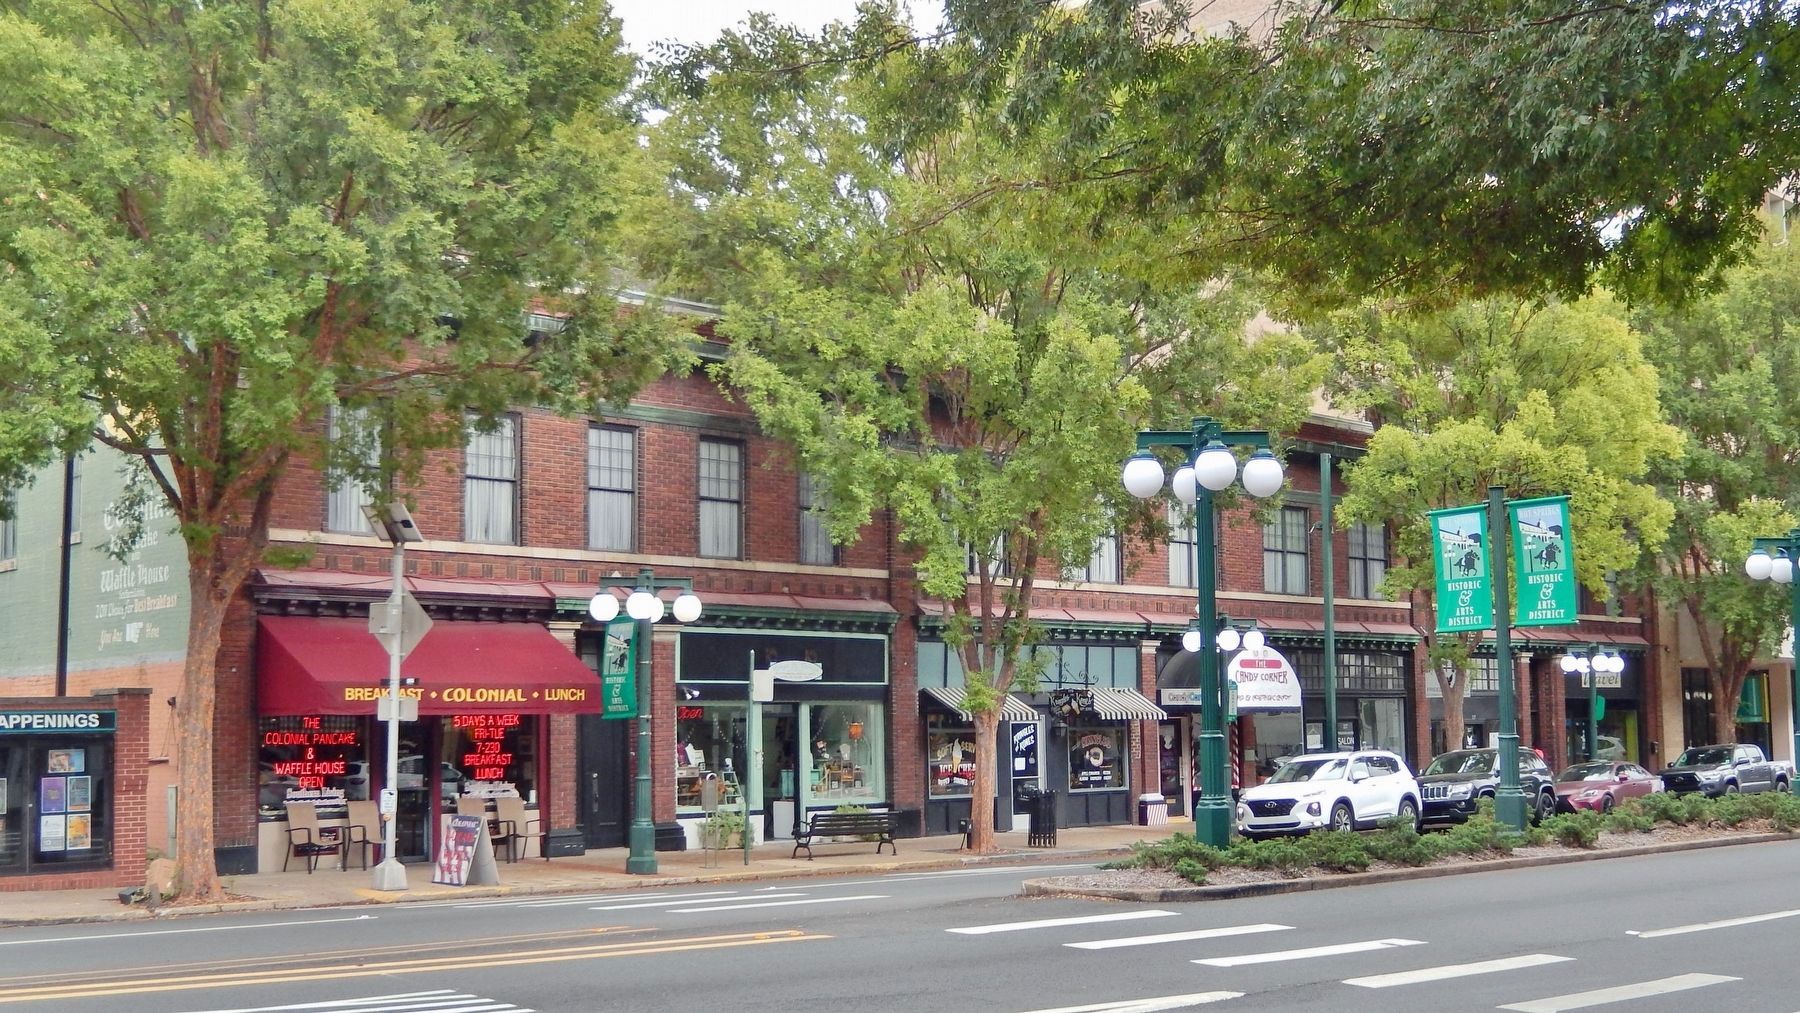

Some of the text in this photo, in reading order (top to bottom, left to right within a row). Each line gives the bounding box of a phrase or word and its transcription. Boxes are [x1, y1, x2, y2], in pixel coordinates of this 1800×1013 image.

[100, 564, 170, 593] Waffle House
[1528, 573, 1563, 584] HISTORIC
[1447, 580, 1482, 592] HISTORIC
[1540, 583, 1554, 600] &
[1458, 590, 1472, 606] &
[1537, 599, 1556, 609] ARTS
[1456, 606, 1474, 616] ARTS
[1528, 609, 1565, 620] DISTRICT
[1448, 616, 1483, 627] DISTRICT
[1235, 670, 1288, 684] CANDY CORNER
[345, 687, 586, 703] BREAKAST COLONIAL LUNCH
[303, 717, 321, 729] THE
[454, 713, 520, 727] 5 DAYS A WEEK
[265, 731, 356, 745] COLONIAL PANCAKE
[1337, 736, 1355, 746] SALON
[307, 747, 315, 760] &
[464, 754, 513, 766] BREAKFAST
[275, 761, 346, 775] WAFFLE HOUSE
[475, 767, 505, 779] LUNCH
[298, 776, 324, 788] OPEN
